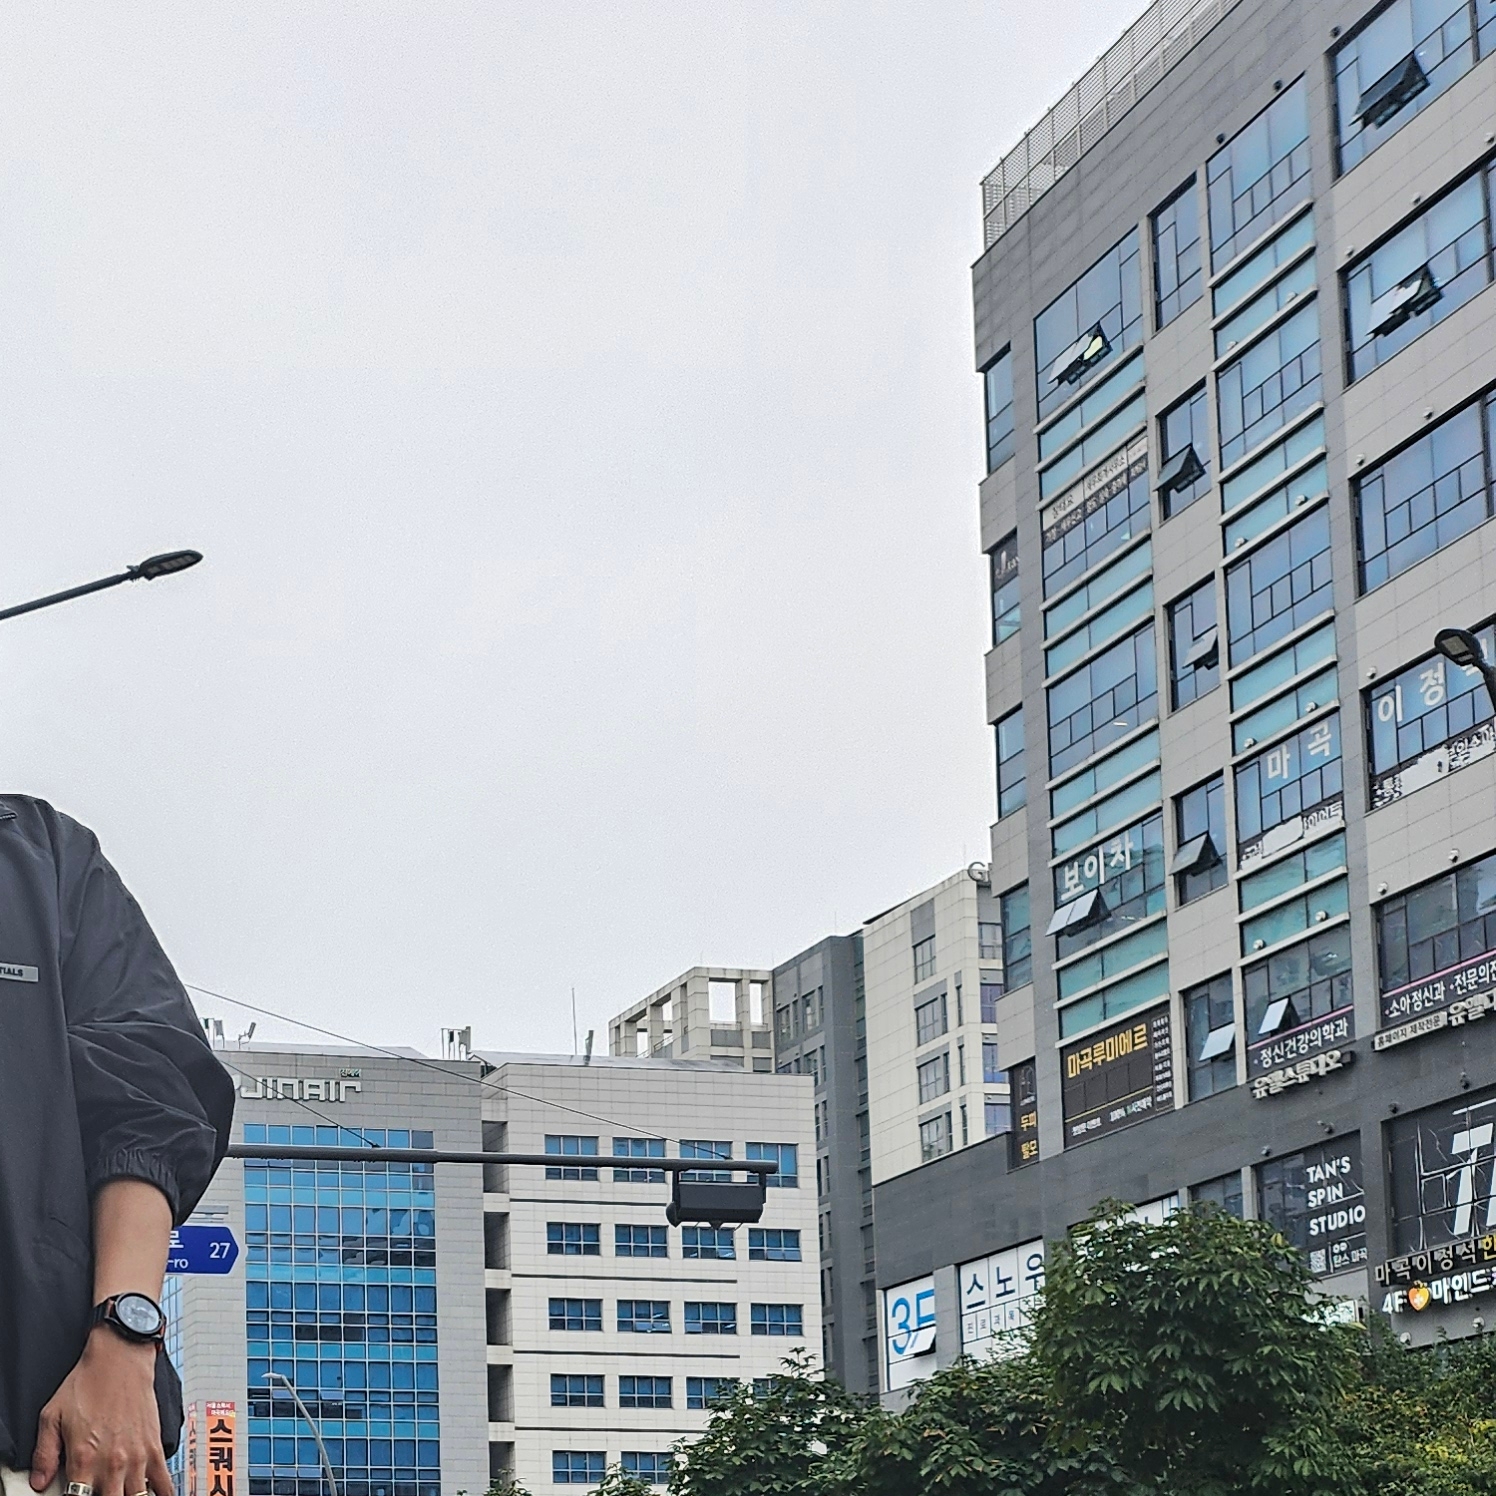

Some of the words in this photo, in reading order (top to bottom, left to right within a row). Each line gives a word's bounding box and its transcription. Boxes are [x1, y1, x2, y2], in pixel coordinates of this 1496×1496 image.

[1060, 830, 1135, 902] 보이차
[1387, 980, 1446, 1018] 소아정신과
[1066, 1023, 1149, 1079] 마곡루미에르
[1260, 1016, 1349, 1069] 정신건강의학과
[1306, 1156, 1351, 1183] TAN'S
[1307, 1182, 1343, 1208] SPIN
[1309, 1204, 1366, 1236] STUDIO
[209, 1242, 231, 1259] 27
[1381, 1290, 1408, 1314] 4F
